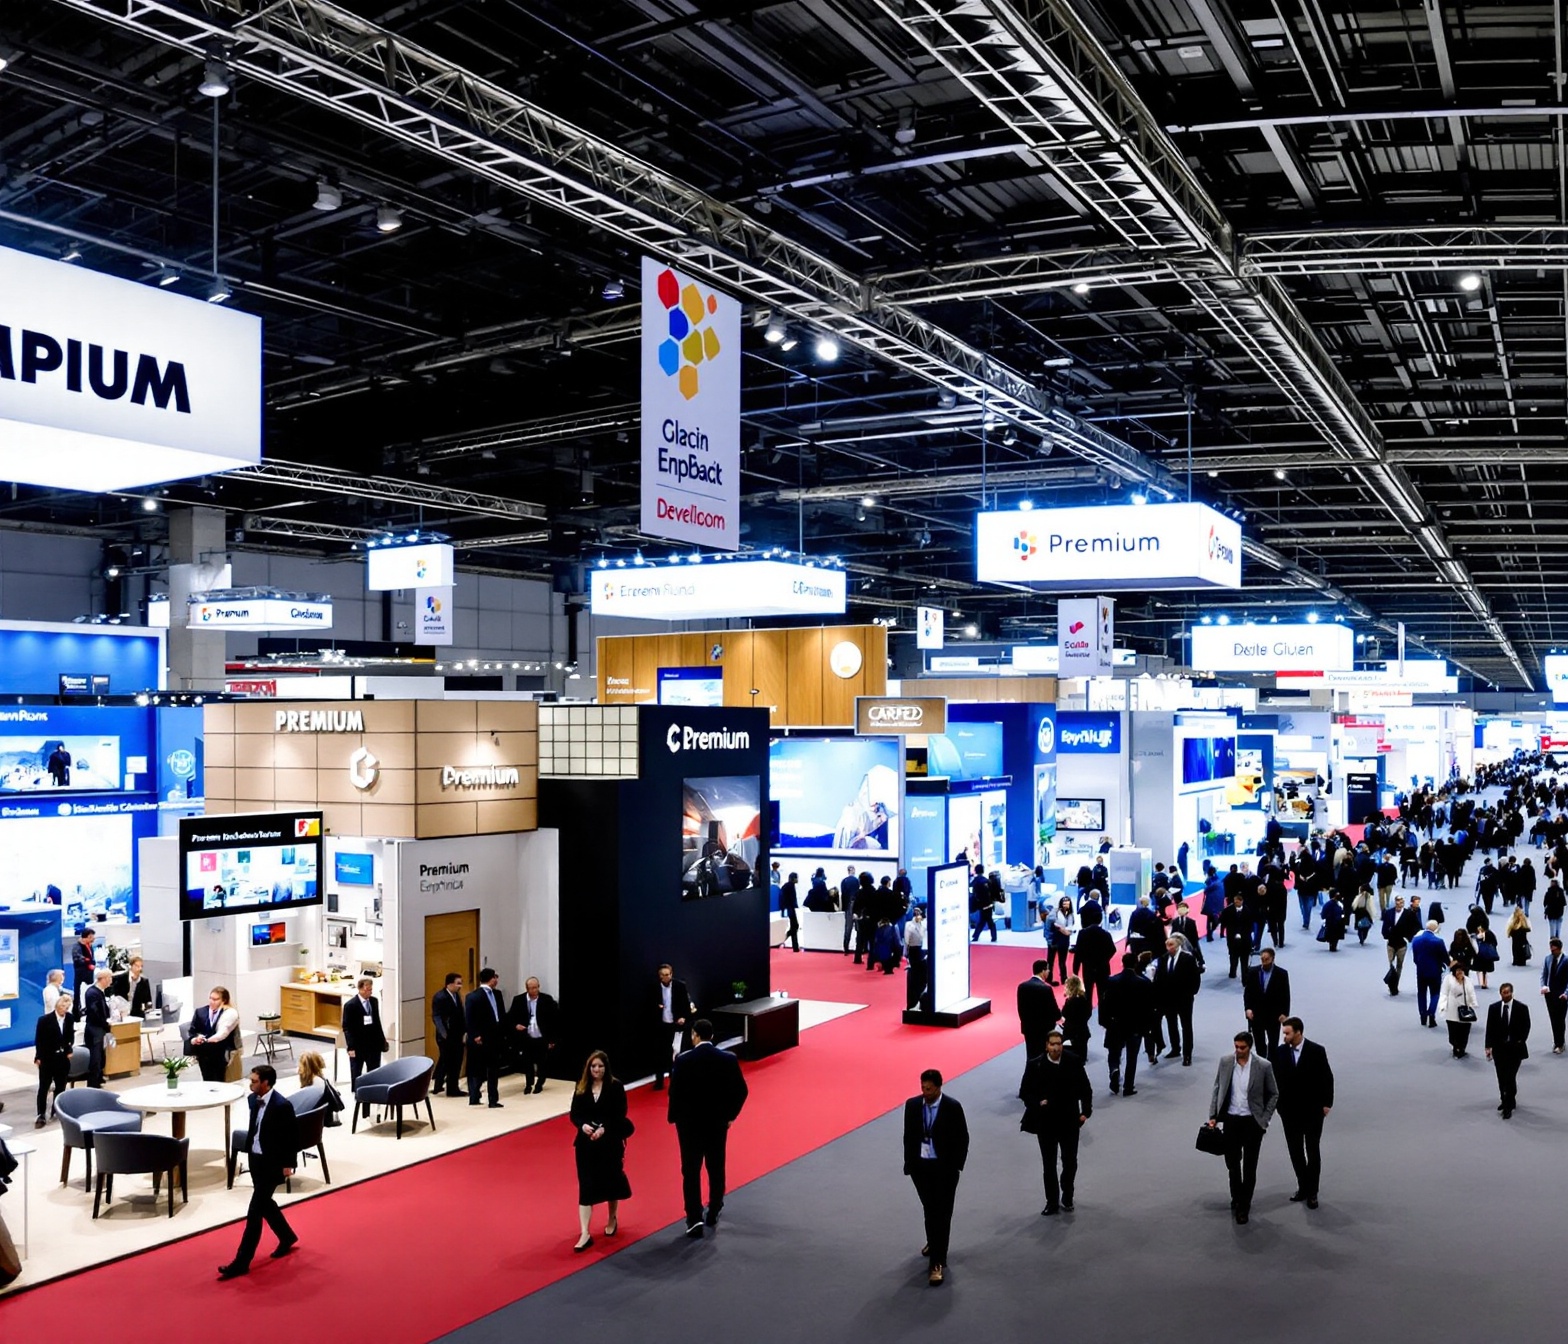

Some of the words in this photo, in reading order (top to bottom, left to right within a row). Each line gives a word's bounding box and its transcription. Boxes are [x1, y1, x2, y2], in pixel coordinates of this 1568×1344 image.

[1049, 531, 1160, 554] Premium
[275, 709, 365, 732] PREMIUM
[682, 726, 751, 750] Premium
[419, 862, 470, 877] Premium
